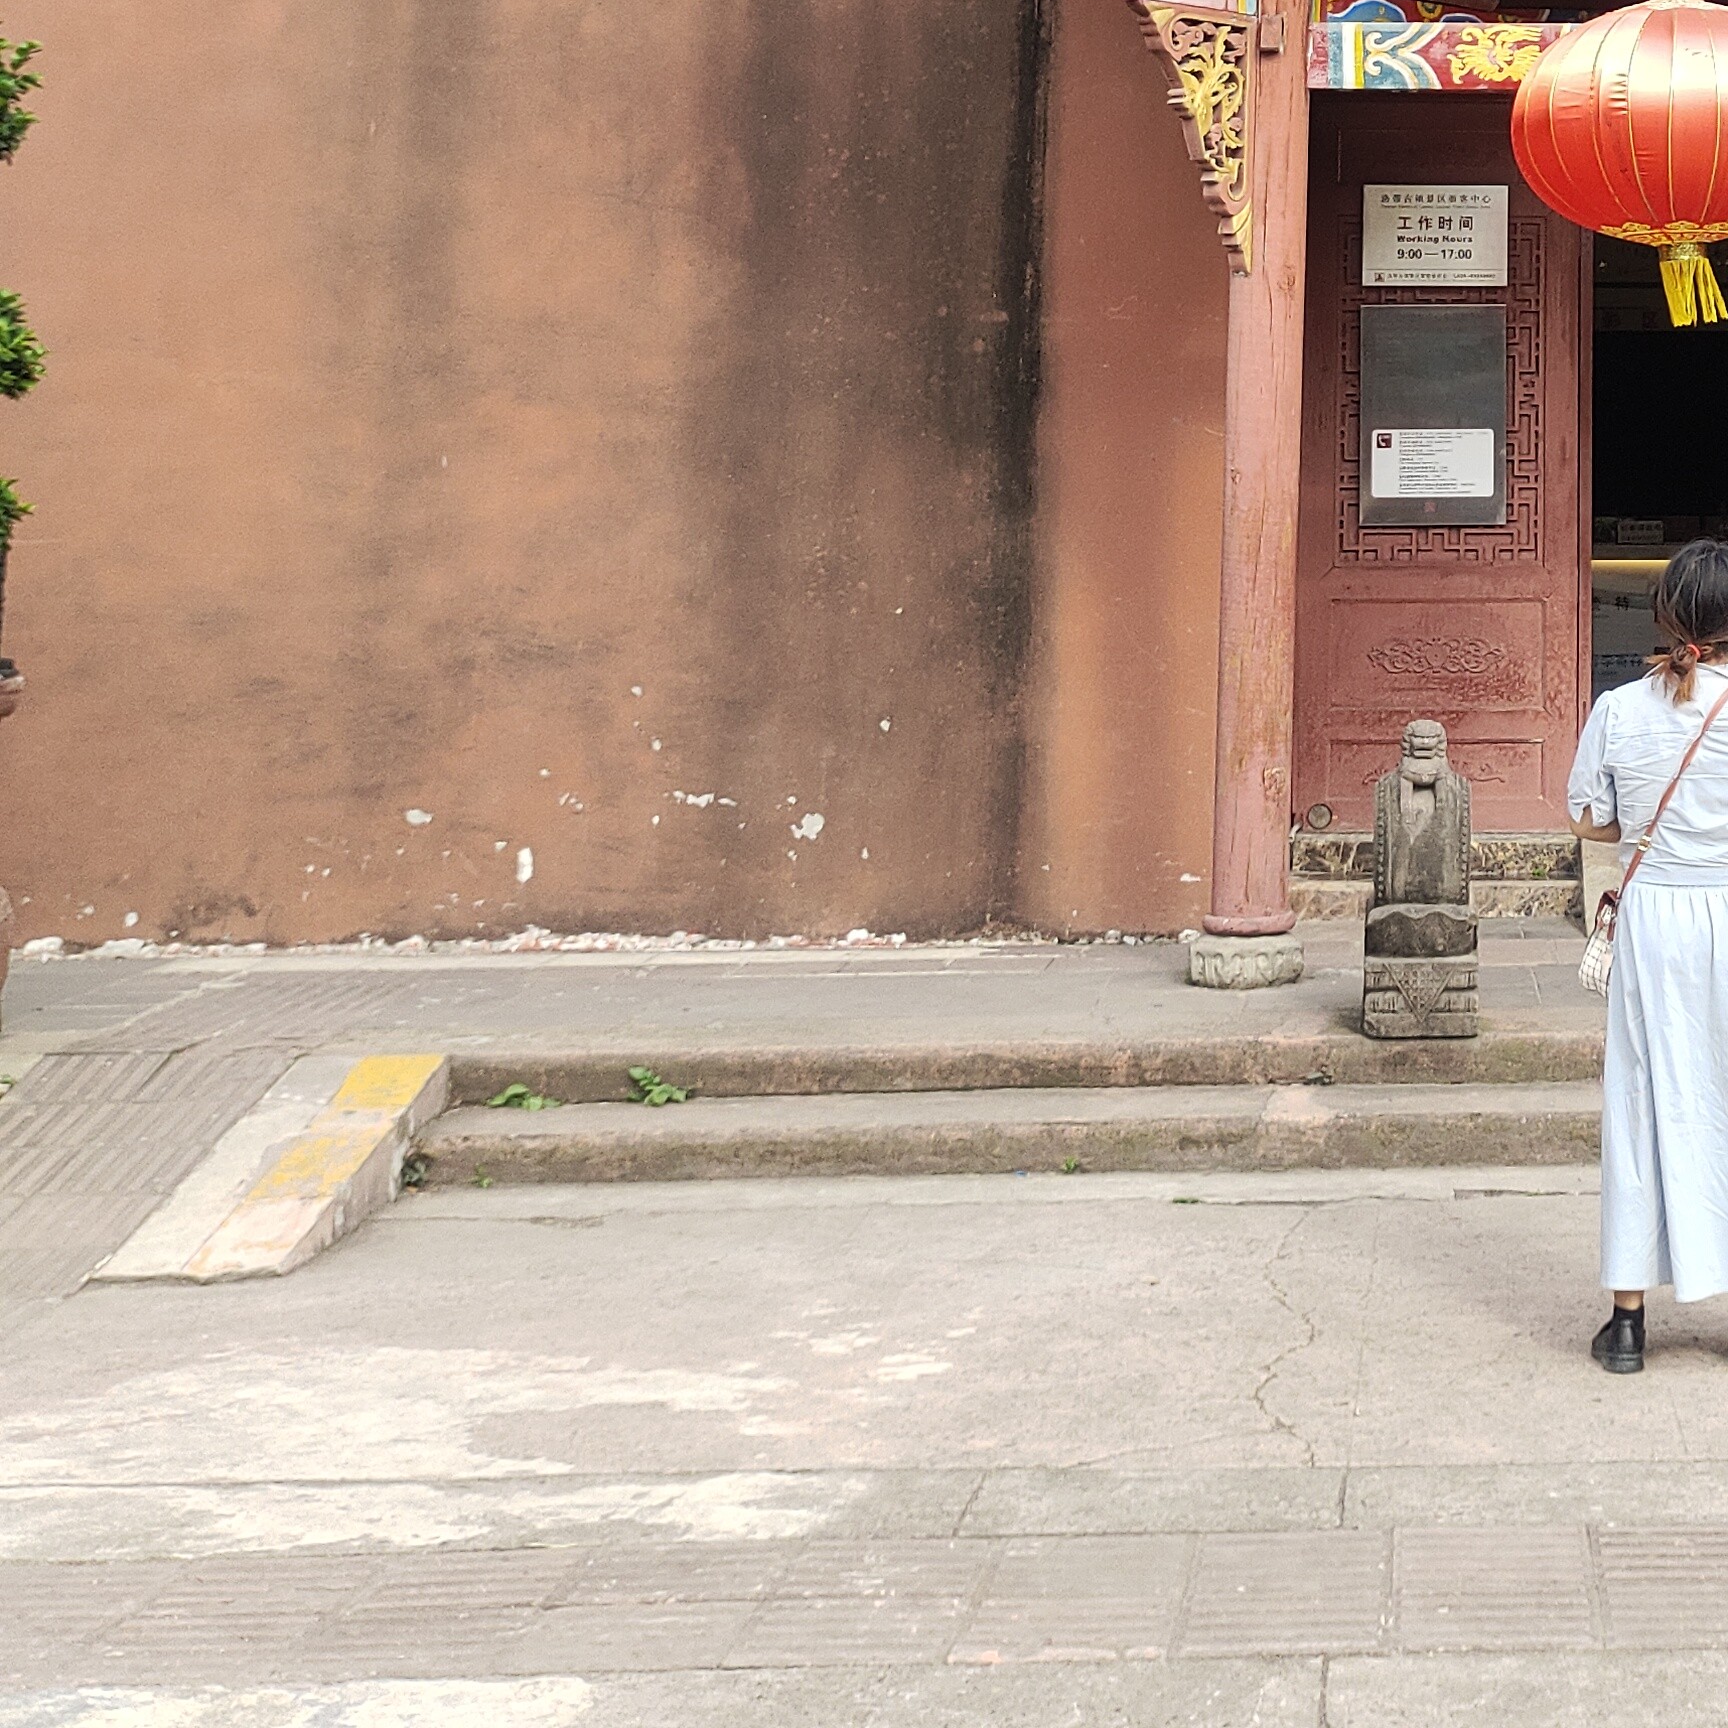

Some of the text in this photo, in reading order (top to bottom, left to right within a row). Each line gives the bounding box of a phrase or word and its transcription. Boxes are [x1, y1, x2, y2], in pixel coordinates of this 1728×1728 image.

[1397, 215, 1474, 231] 工作时间
[1397, 235, 1473, 244] Working Hours
